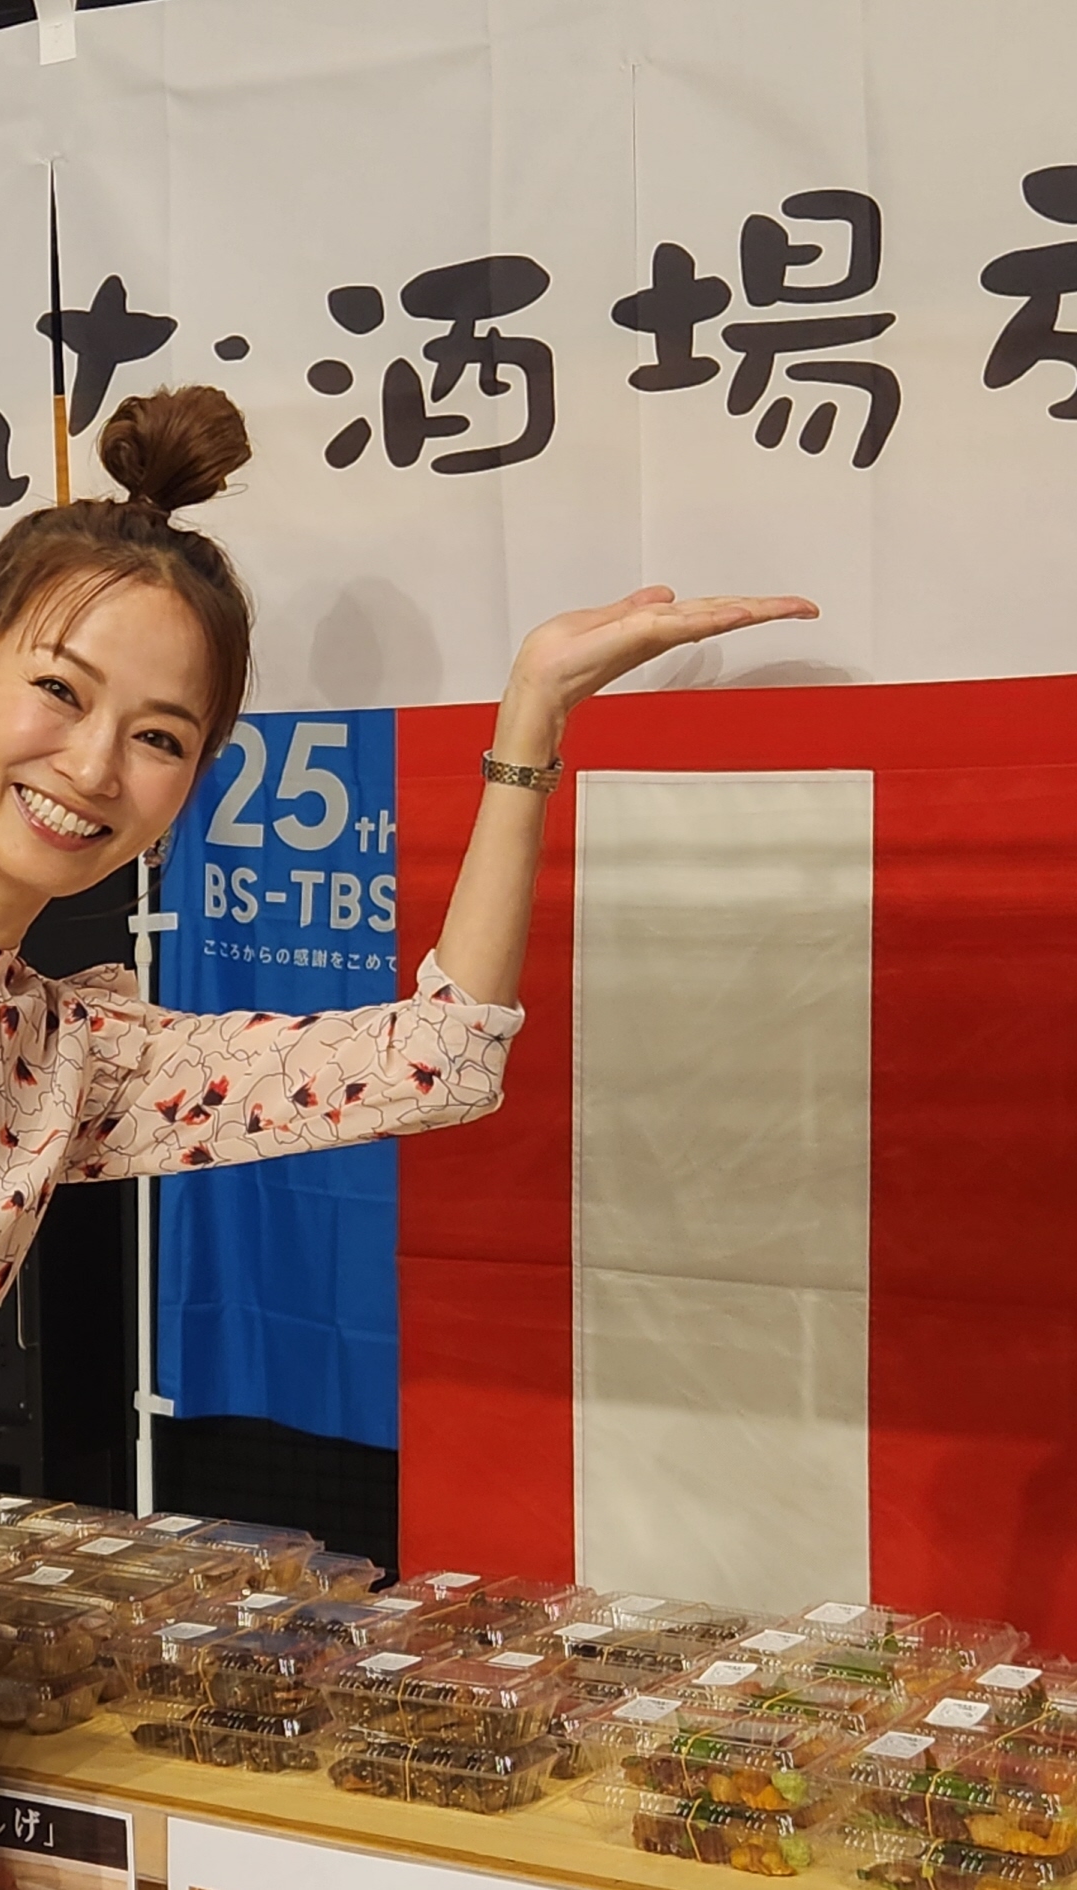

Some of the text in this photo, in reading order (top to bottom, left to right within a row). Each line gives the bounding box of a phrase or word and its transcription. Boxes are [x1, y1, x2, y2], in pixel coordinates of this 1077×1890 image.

[205, 720, 396, 853] 25th
[205, 863, 396, 932] BS-TBS
[204, 939, 397, 972] こころからの感謝をこめて
